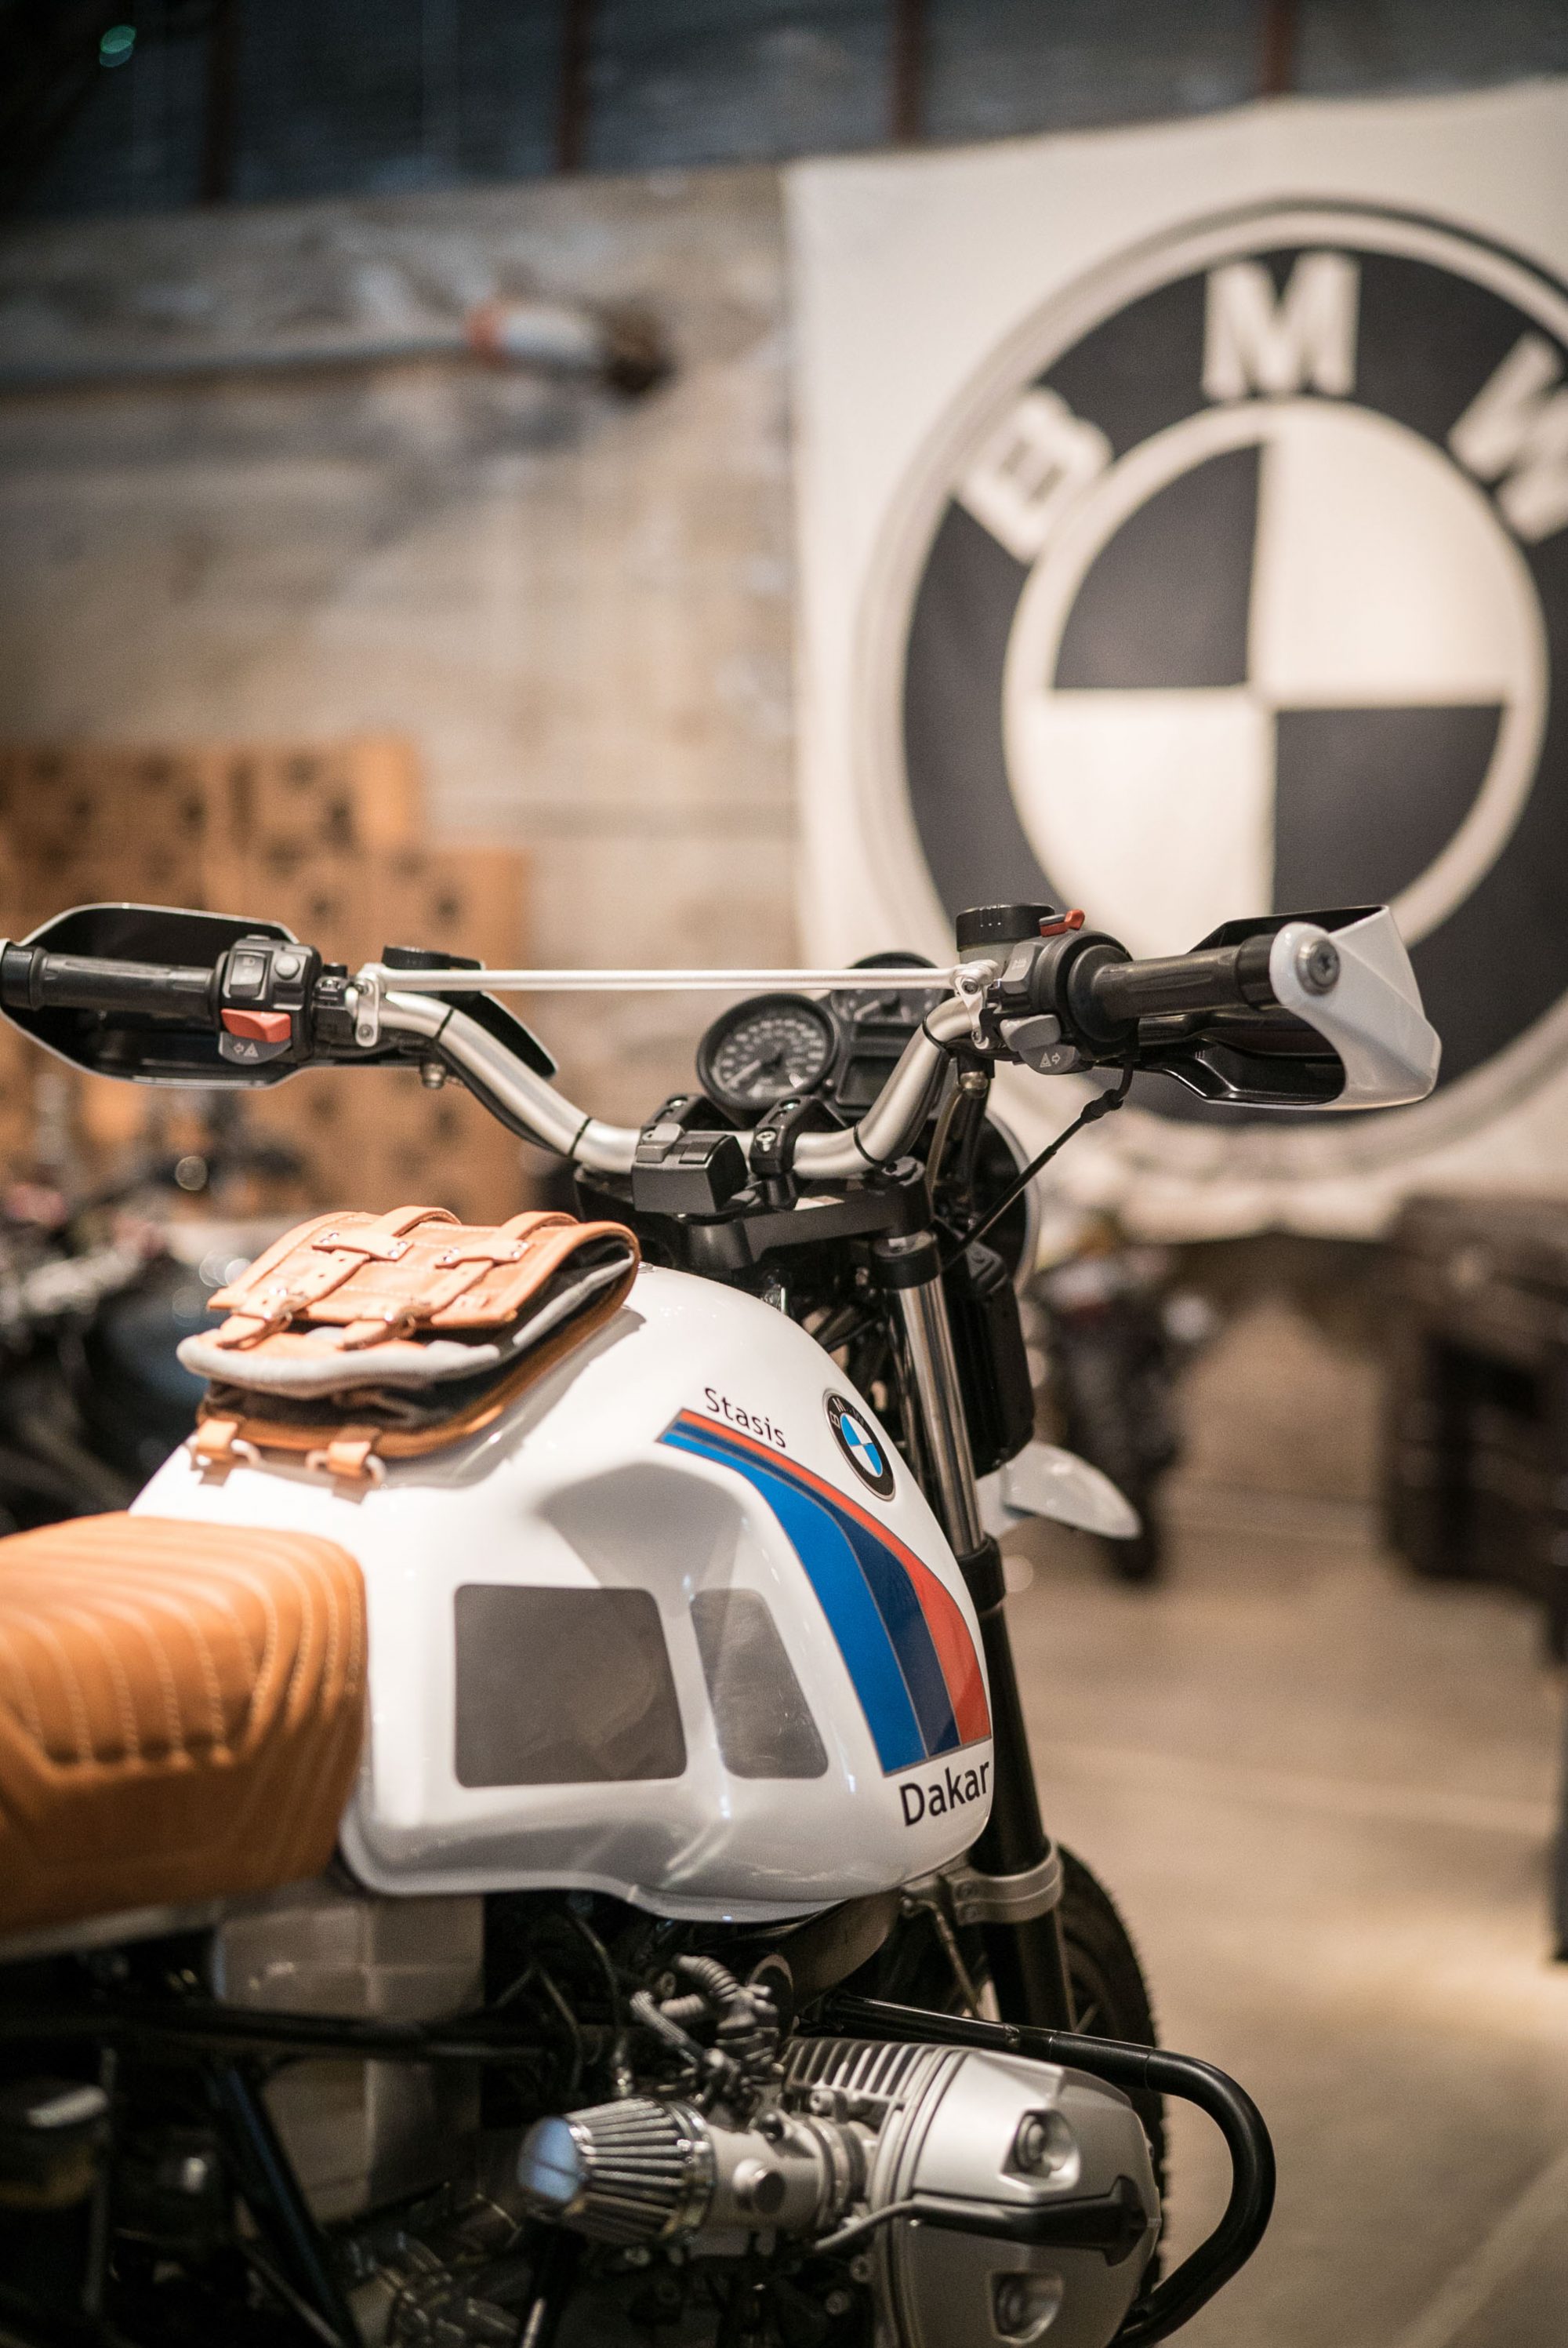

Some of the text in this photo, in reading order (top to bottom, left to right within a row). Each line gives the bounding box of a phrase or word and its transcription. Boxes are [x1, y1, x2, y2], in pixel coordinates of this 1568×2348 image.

[950, 249, 1568, 566] BMW
[704, 1387, 786, 1448] Stasis
[829, 1397, 865, 1430] BMW
[899, 1761, 989, 1826] Dakar
